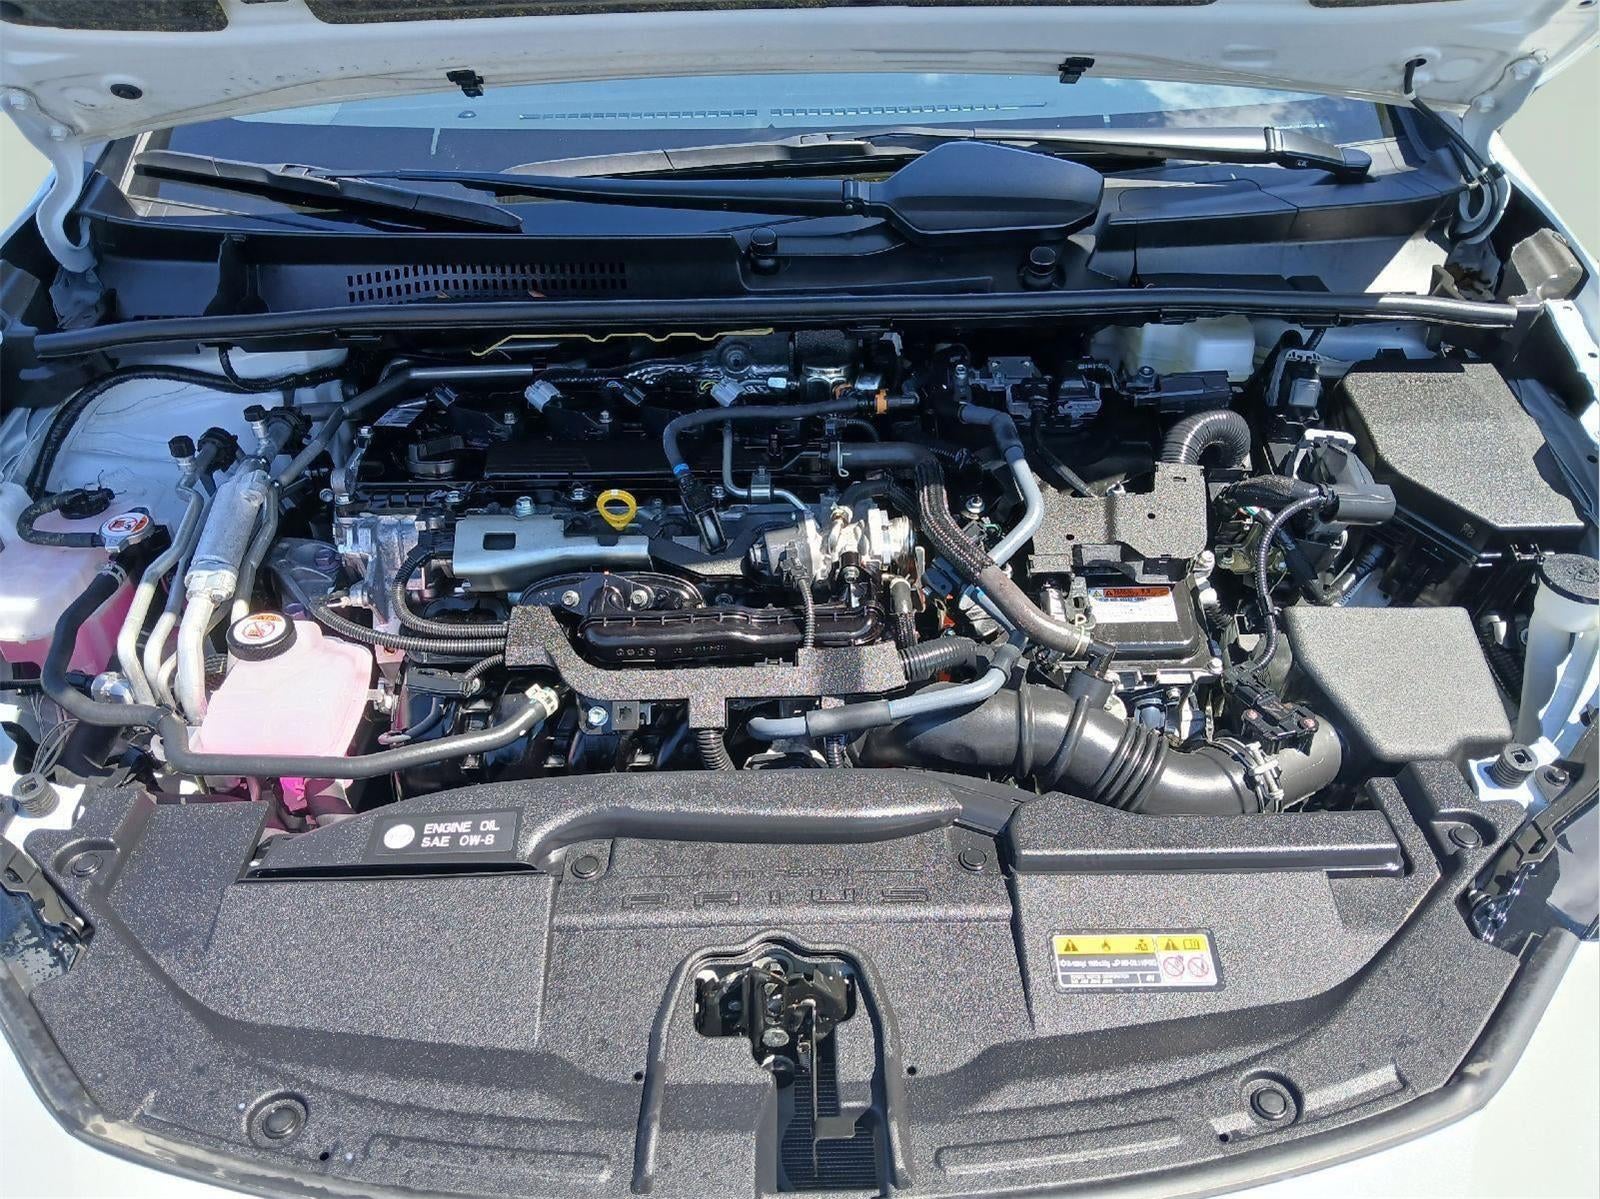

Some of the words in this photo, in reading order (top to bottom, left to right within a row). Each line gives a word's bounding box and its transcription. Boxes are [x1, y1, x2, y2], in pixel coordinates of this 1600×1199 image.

[423, 820, 472, 834] ENGINE
[479, 819, 500, 831] OIL
[420, 835, 451, 847] SAE
